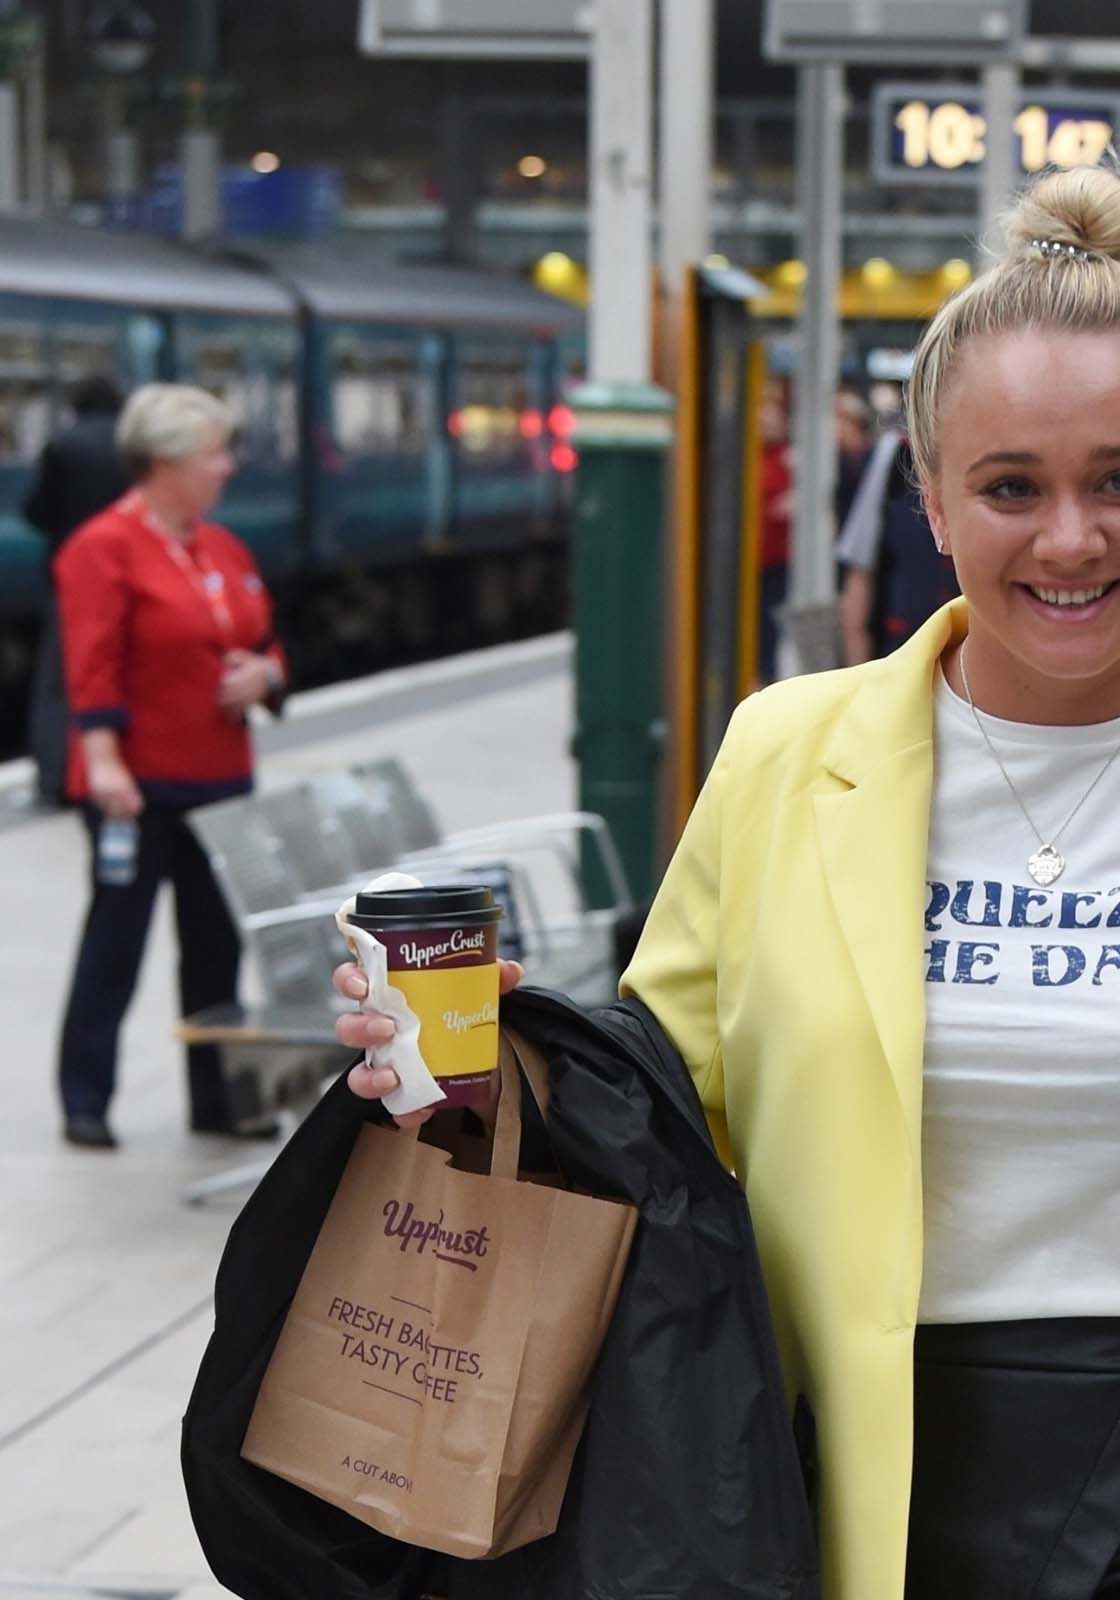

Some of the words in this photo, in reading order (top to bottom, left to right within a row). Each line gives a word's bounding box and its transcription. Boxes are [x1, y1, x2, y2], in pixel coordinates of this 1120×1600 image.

[925, 938, 1001, 985] HE
[328, 1297, 394, 1338] FRESH
[341, 1333, 410, 1376] TASTY
[341, 1455, 350, 1468] A
[353, 1459, 380, 1478] CUT
